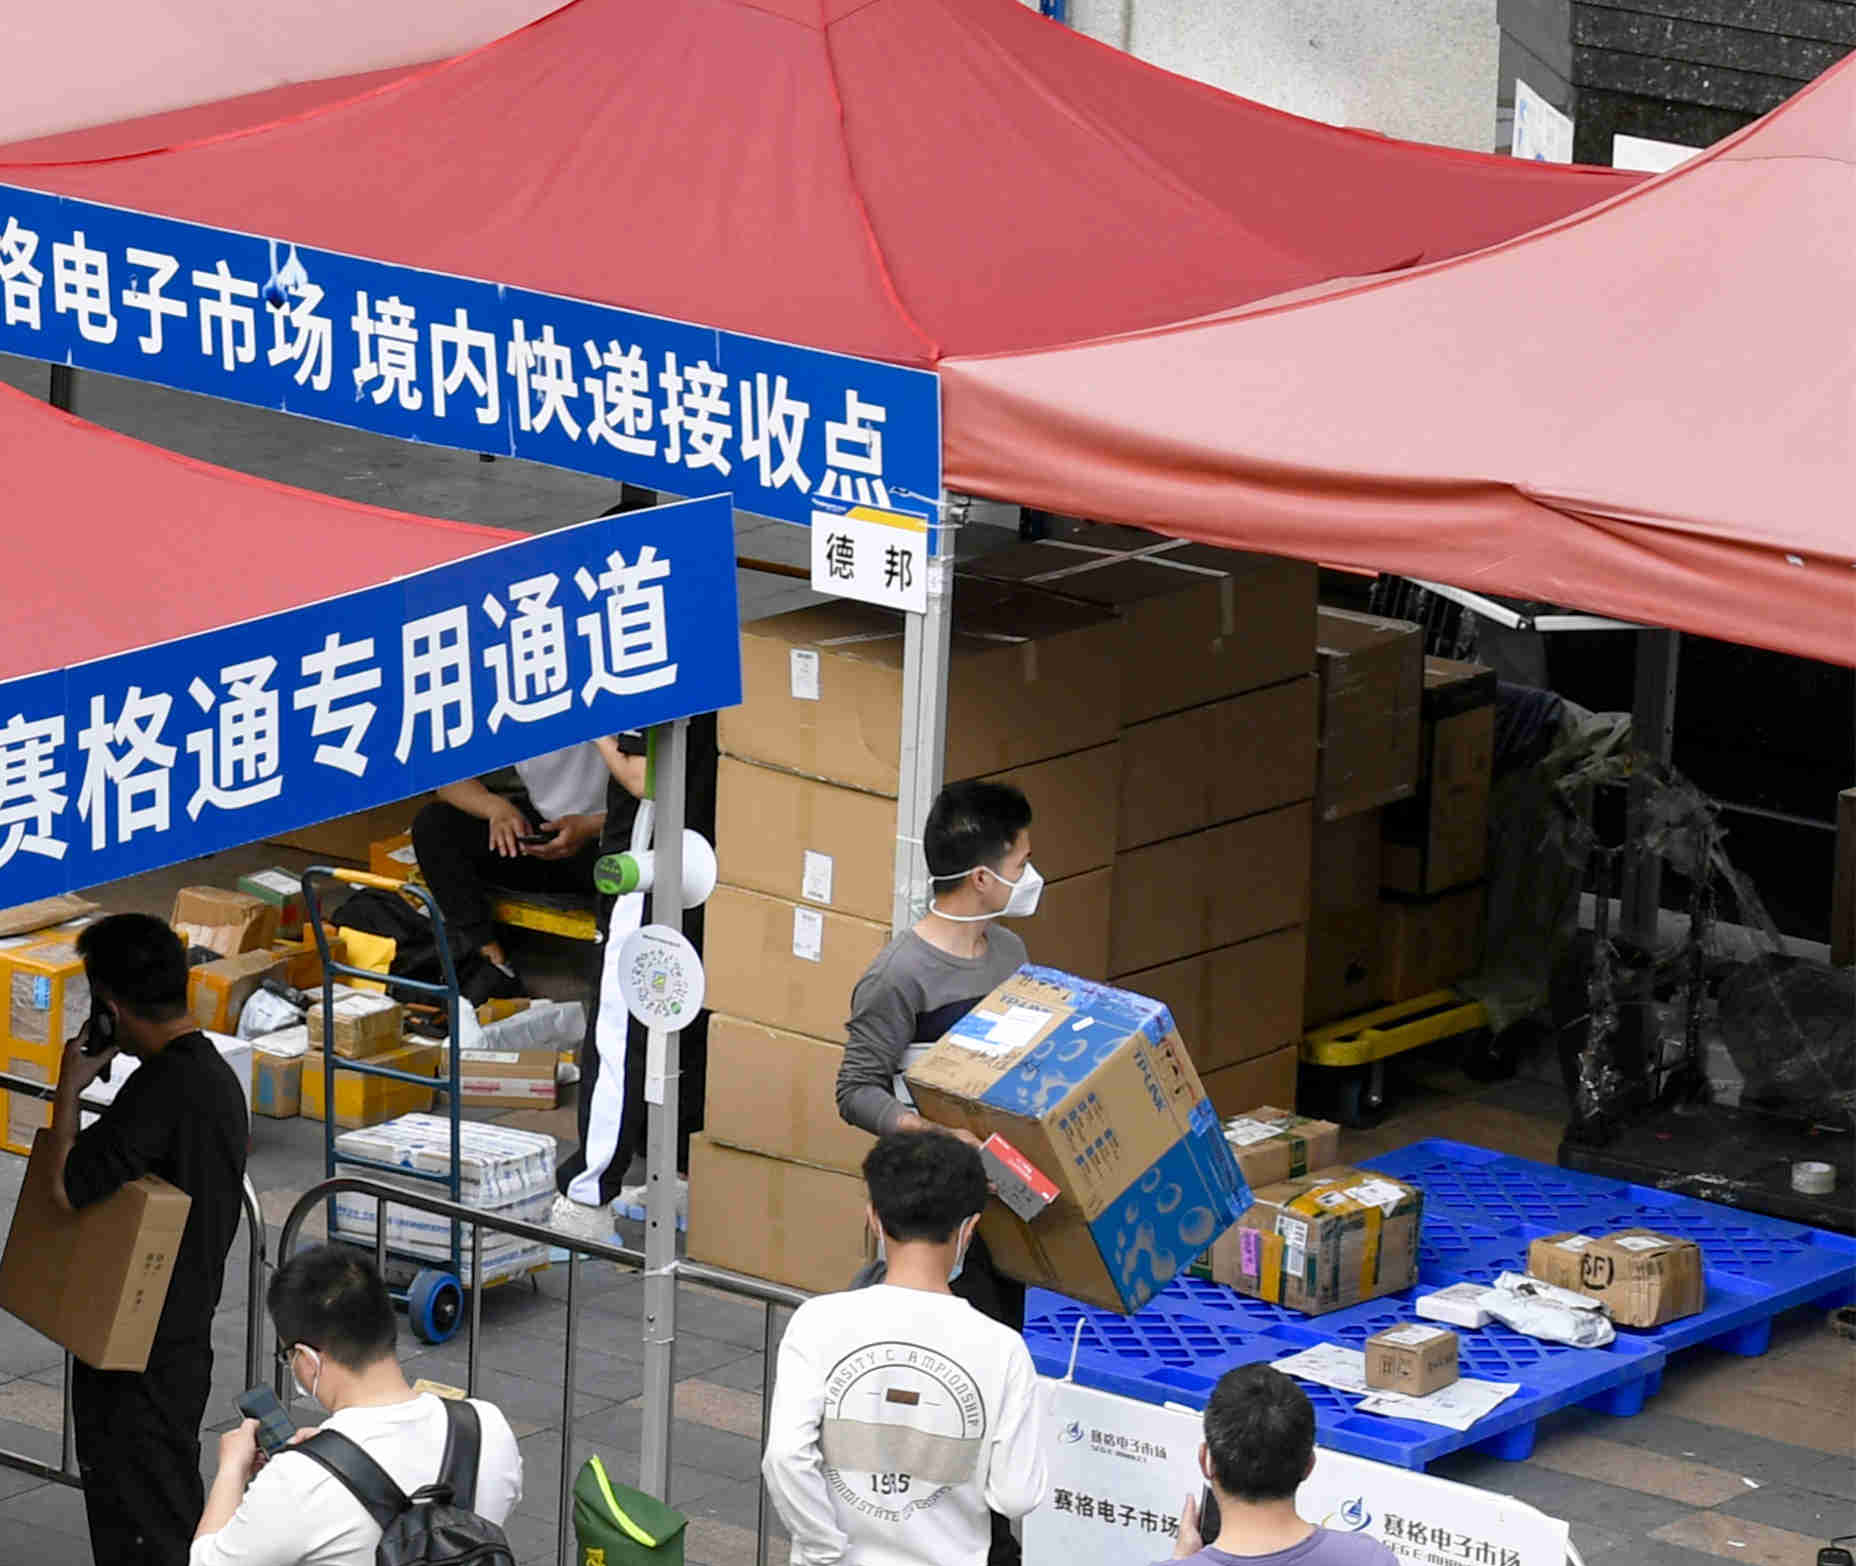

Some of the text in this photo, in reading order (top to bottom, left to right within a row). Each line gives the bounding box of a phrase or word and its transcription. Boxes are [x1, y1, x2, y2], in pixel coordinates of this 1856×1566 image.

[825, 532, 913, 592] 德邦
[1090, 1428, 1168, 1461] 赛格电子市场
[1053, 1487, 1181, 1539] 赛格电子市场
